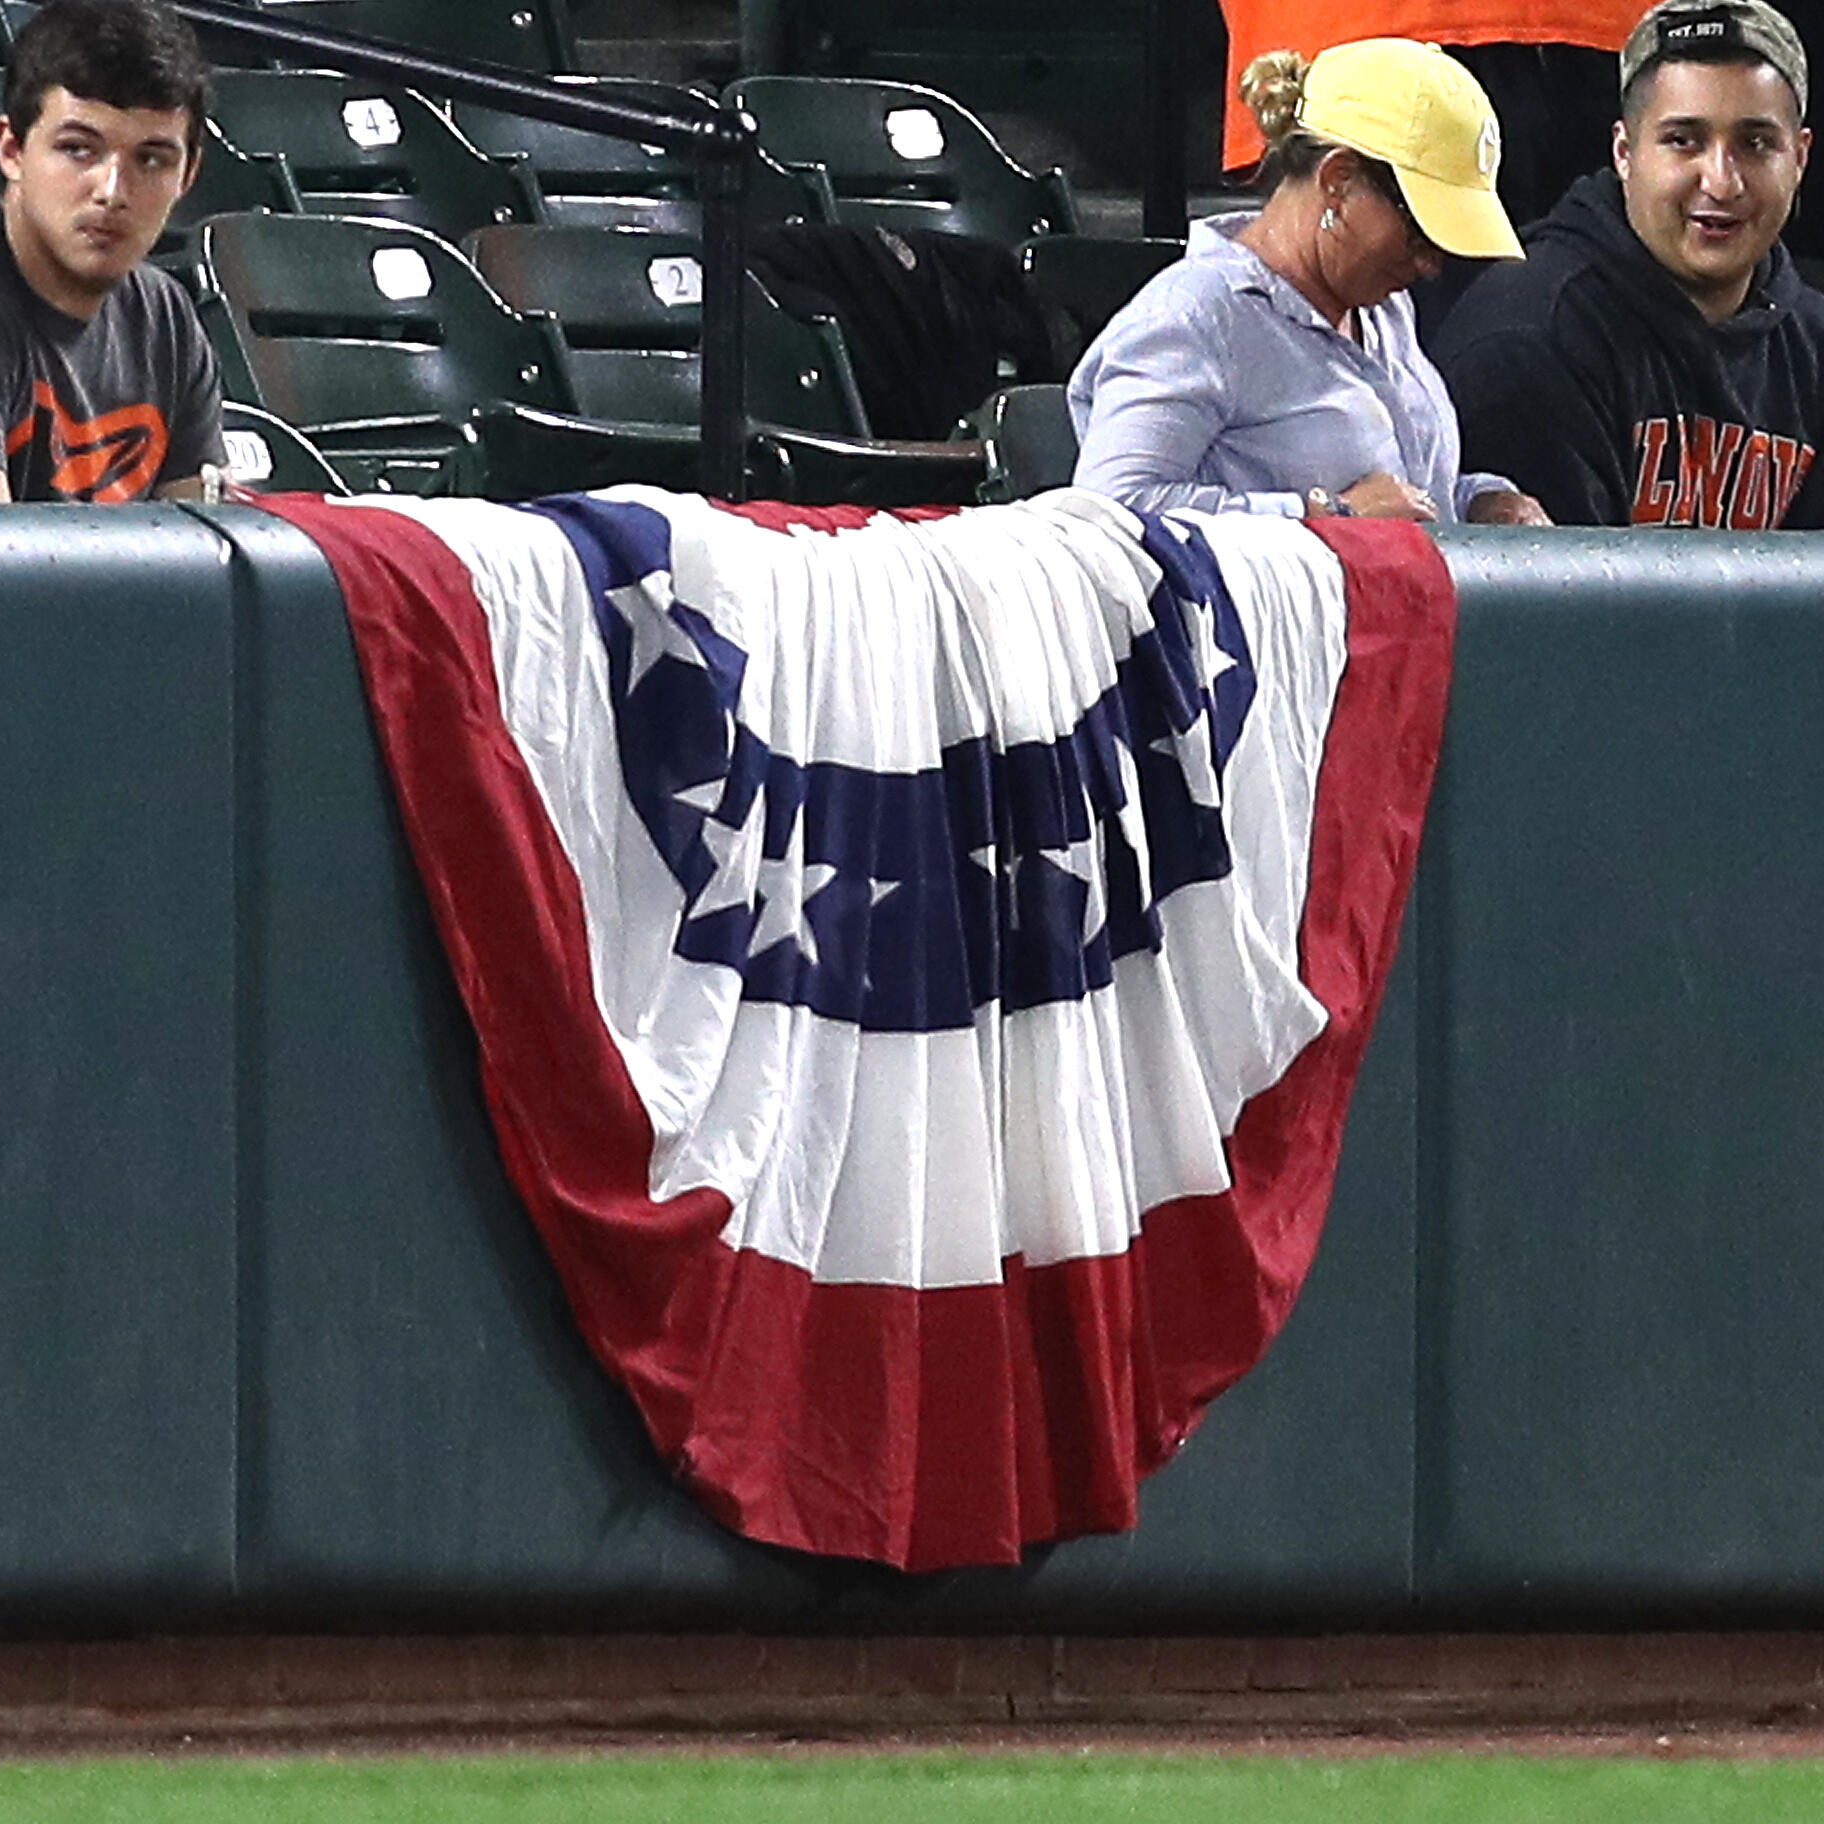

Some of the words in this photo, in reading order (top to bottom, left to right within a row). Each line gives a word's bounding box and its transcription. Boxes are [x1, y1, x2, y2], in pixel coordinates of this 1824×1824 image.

[365, 107, 381, 136] 4
[669, 264, 689, 296] 2
[227, 439, 260, 470] 20
